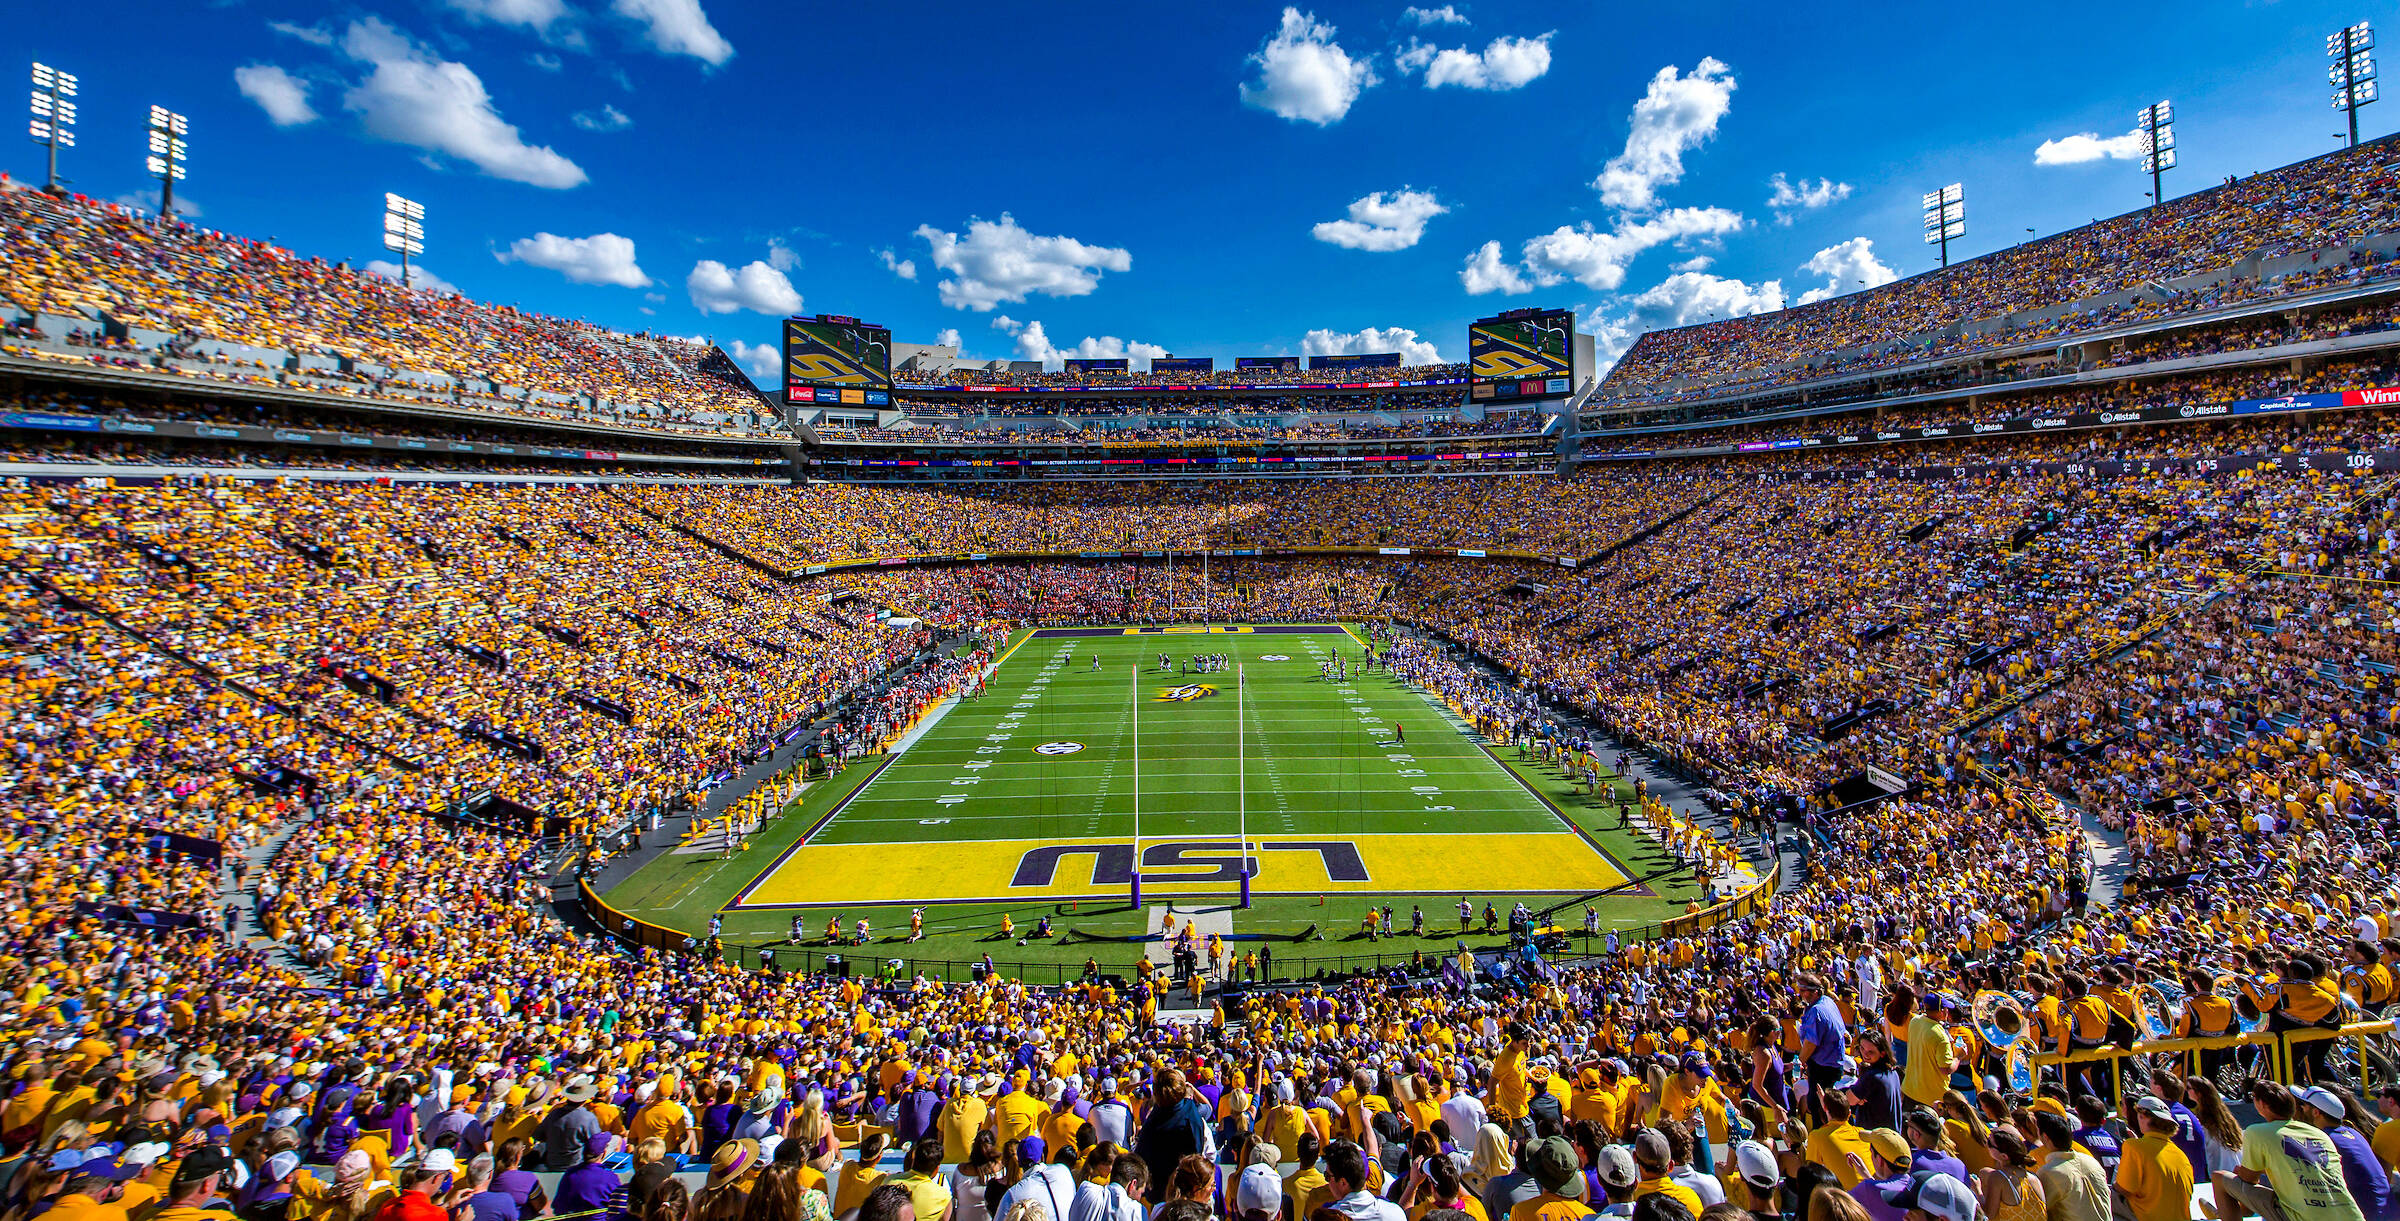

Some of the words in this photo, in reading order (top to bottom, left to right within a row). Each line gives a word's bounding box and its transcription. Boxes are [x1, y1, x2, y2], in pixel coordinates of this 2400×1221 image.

[2194, 404, 2227, 415] Allstate
[2113, 412, 2140, 421] Allstate
[2043, 418, 2066, 427] Allstate
[2196, 460, 2218, 471] 105
[2346, 454, 2374, 467] 106
[2066, 464, 2084, 474] 104
[1386, 754, 1416, 762] 20
[964, 760, 992, 769] 20
[1397, 769, 1427, 777] 15
[950, 777, 981, 785] 15
[1410, 786, 1442, 795] 10
[936, 794, 969, 804] 10
[1009, 842, 1372, 888] LSU
[2174, 1114, 2194, 1141] 7
[2304, 1198, 2327, 1208] LSU
